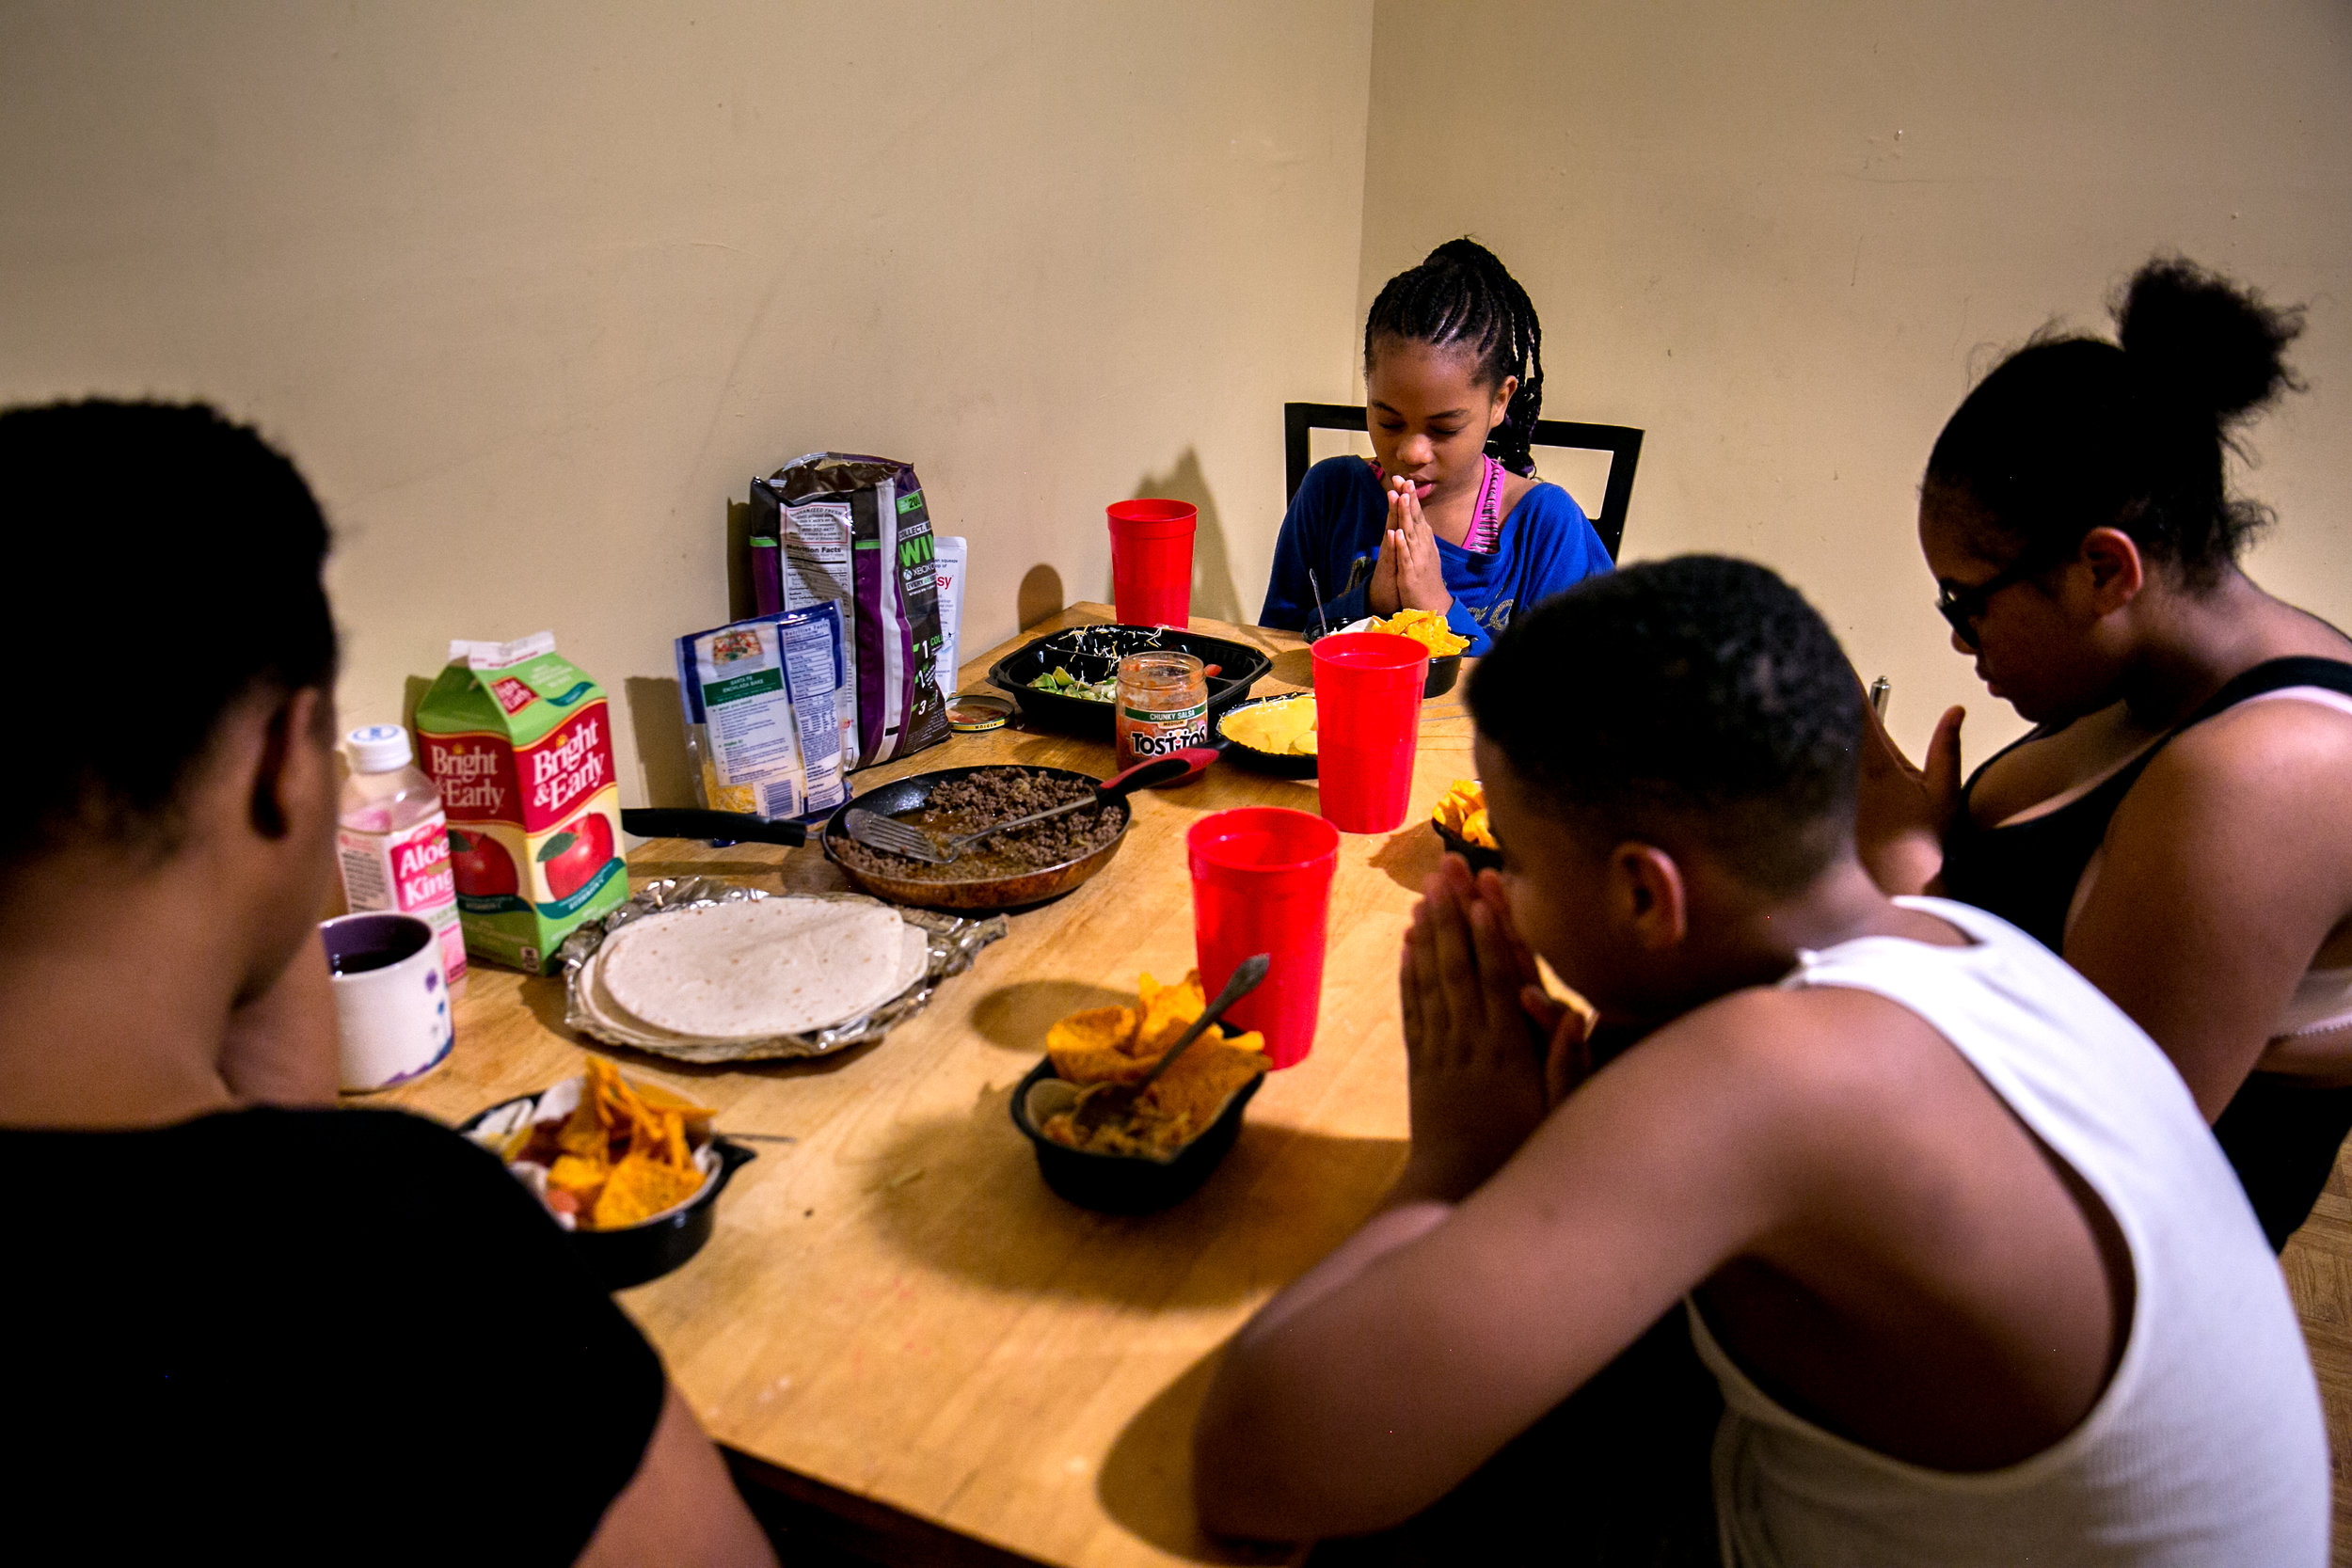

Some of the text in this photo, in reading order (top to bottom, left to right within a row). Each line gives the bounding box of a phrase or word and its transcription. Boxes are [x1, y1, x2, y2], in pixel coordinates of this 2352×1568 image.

[787, 544, 819, 553] Nutrition
[913, 564, 931, 577] XBOX
[922, 640, 929, 658] 1
[918, 699, 927, 715] 3
[1150, 709, 1196, 721] CHUNKY SALSA
[431, 745, 499, 783] Bright
[532, 718, 598, 785] Bright
[532, 752, 605, 812] &Early
[400, 837, 451, 879] Aloe
[404, 867, 453, 908] King
